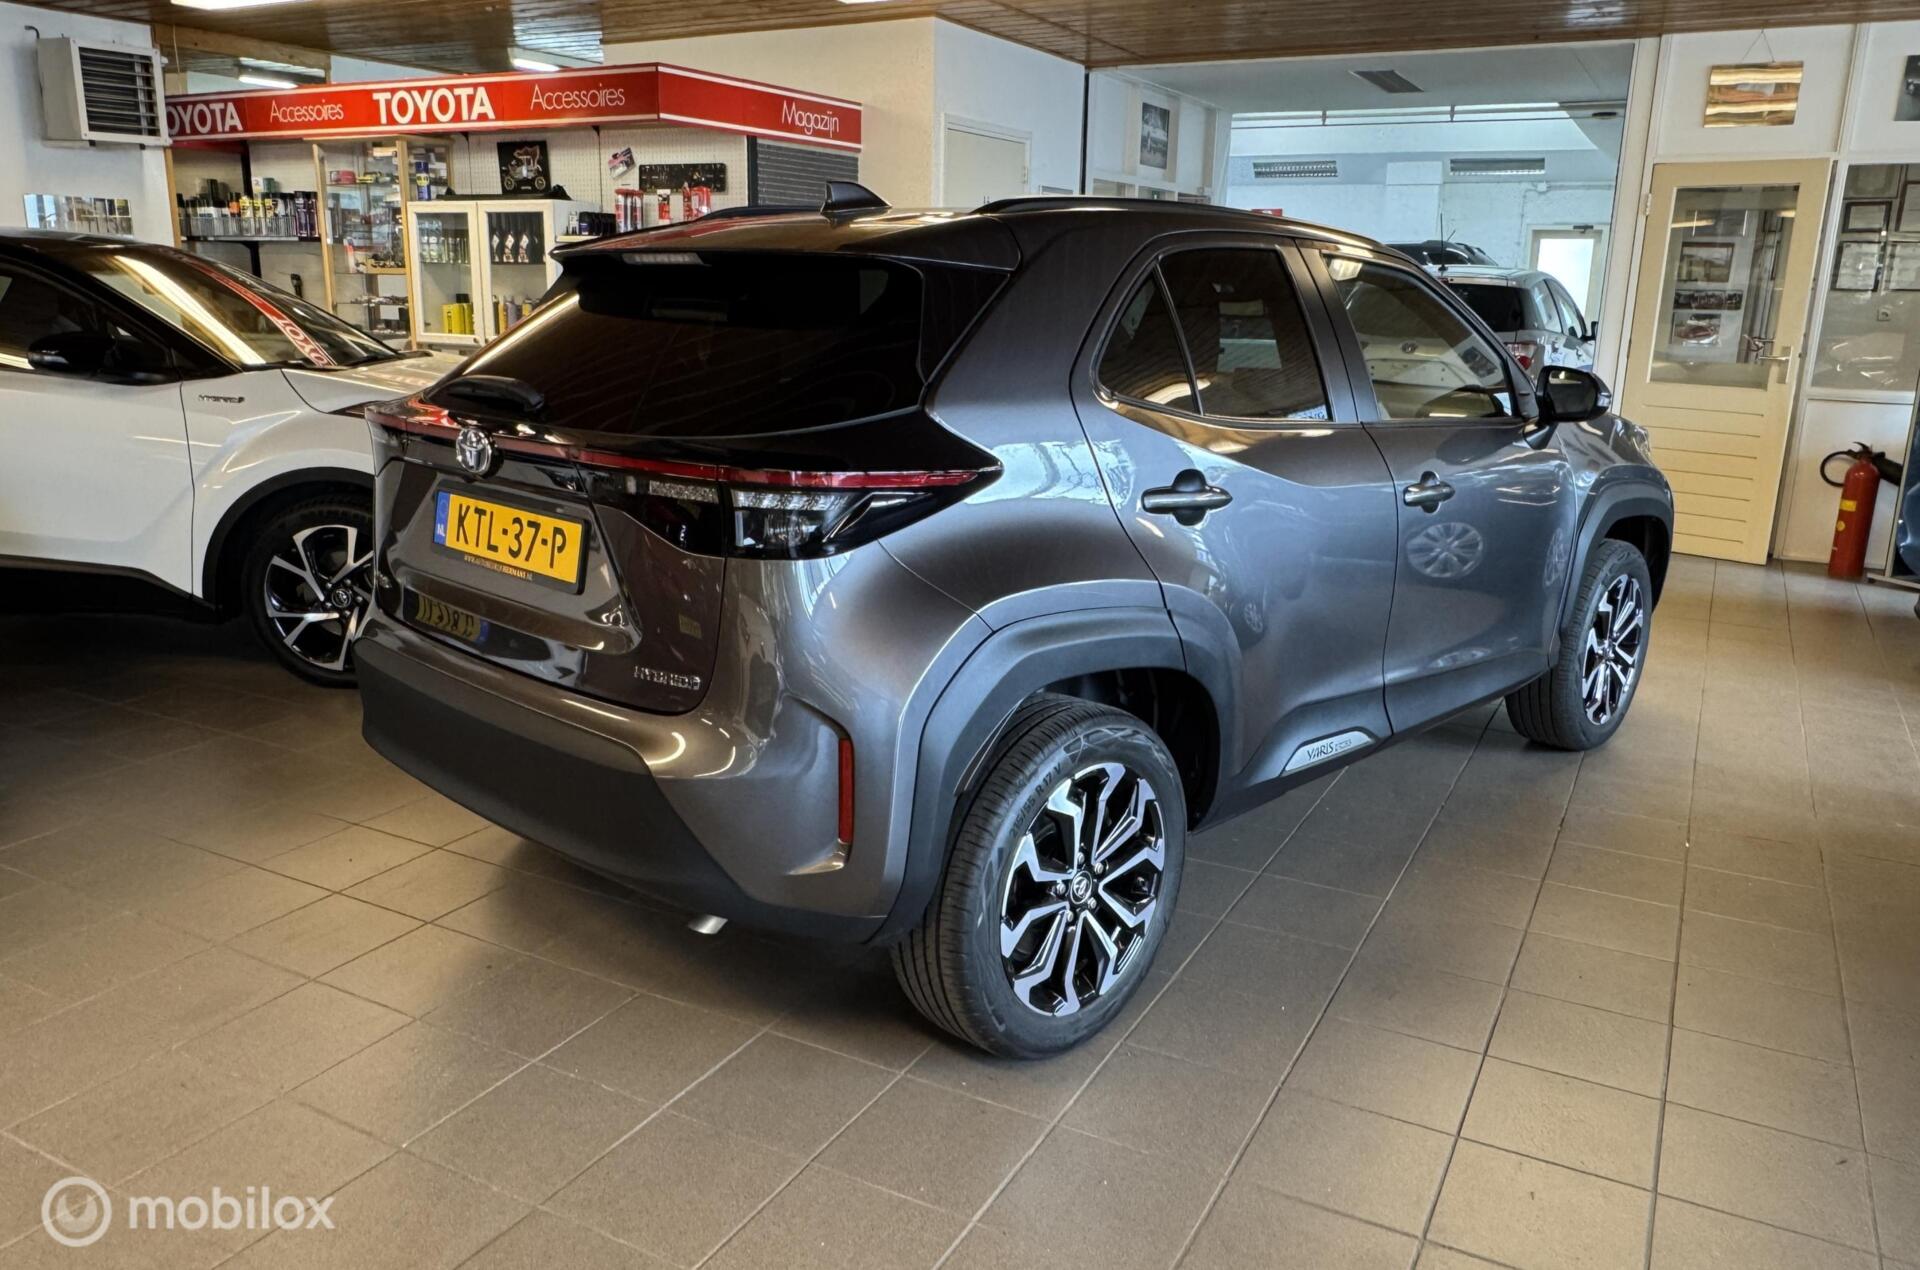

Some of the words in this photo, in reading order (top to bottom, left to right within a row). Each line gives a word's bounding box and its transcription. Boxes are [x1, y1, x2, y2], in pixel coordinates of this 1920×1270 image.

[269, 99, 344, 123] Accessoires
[372, 86, 496, 124] TOYOTA
[529, 83, 625, 111] Accessoires
[166, 102, 244, 134] OYOTA
[781, 100, 840, 138] Magazijn
[456, 503, 567, 569] KTL-37-P
[1306, 741, 1335, 760] YARIS
